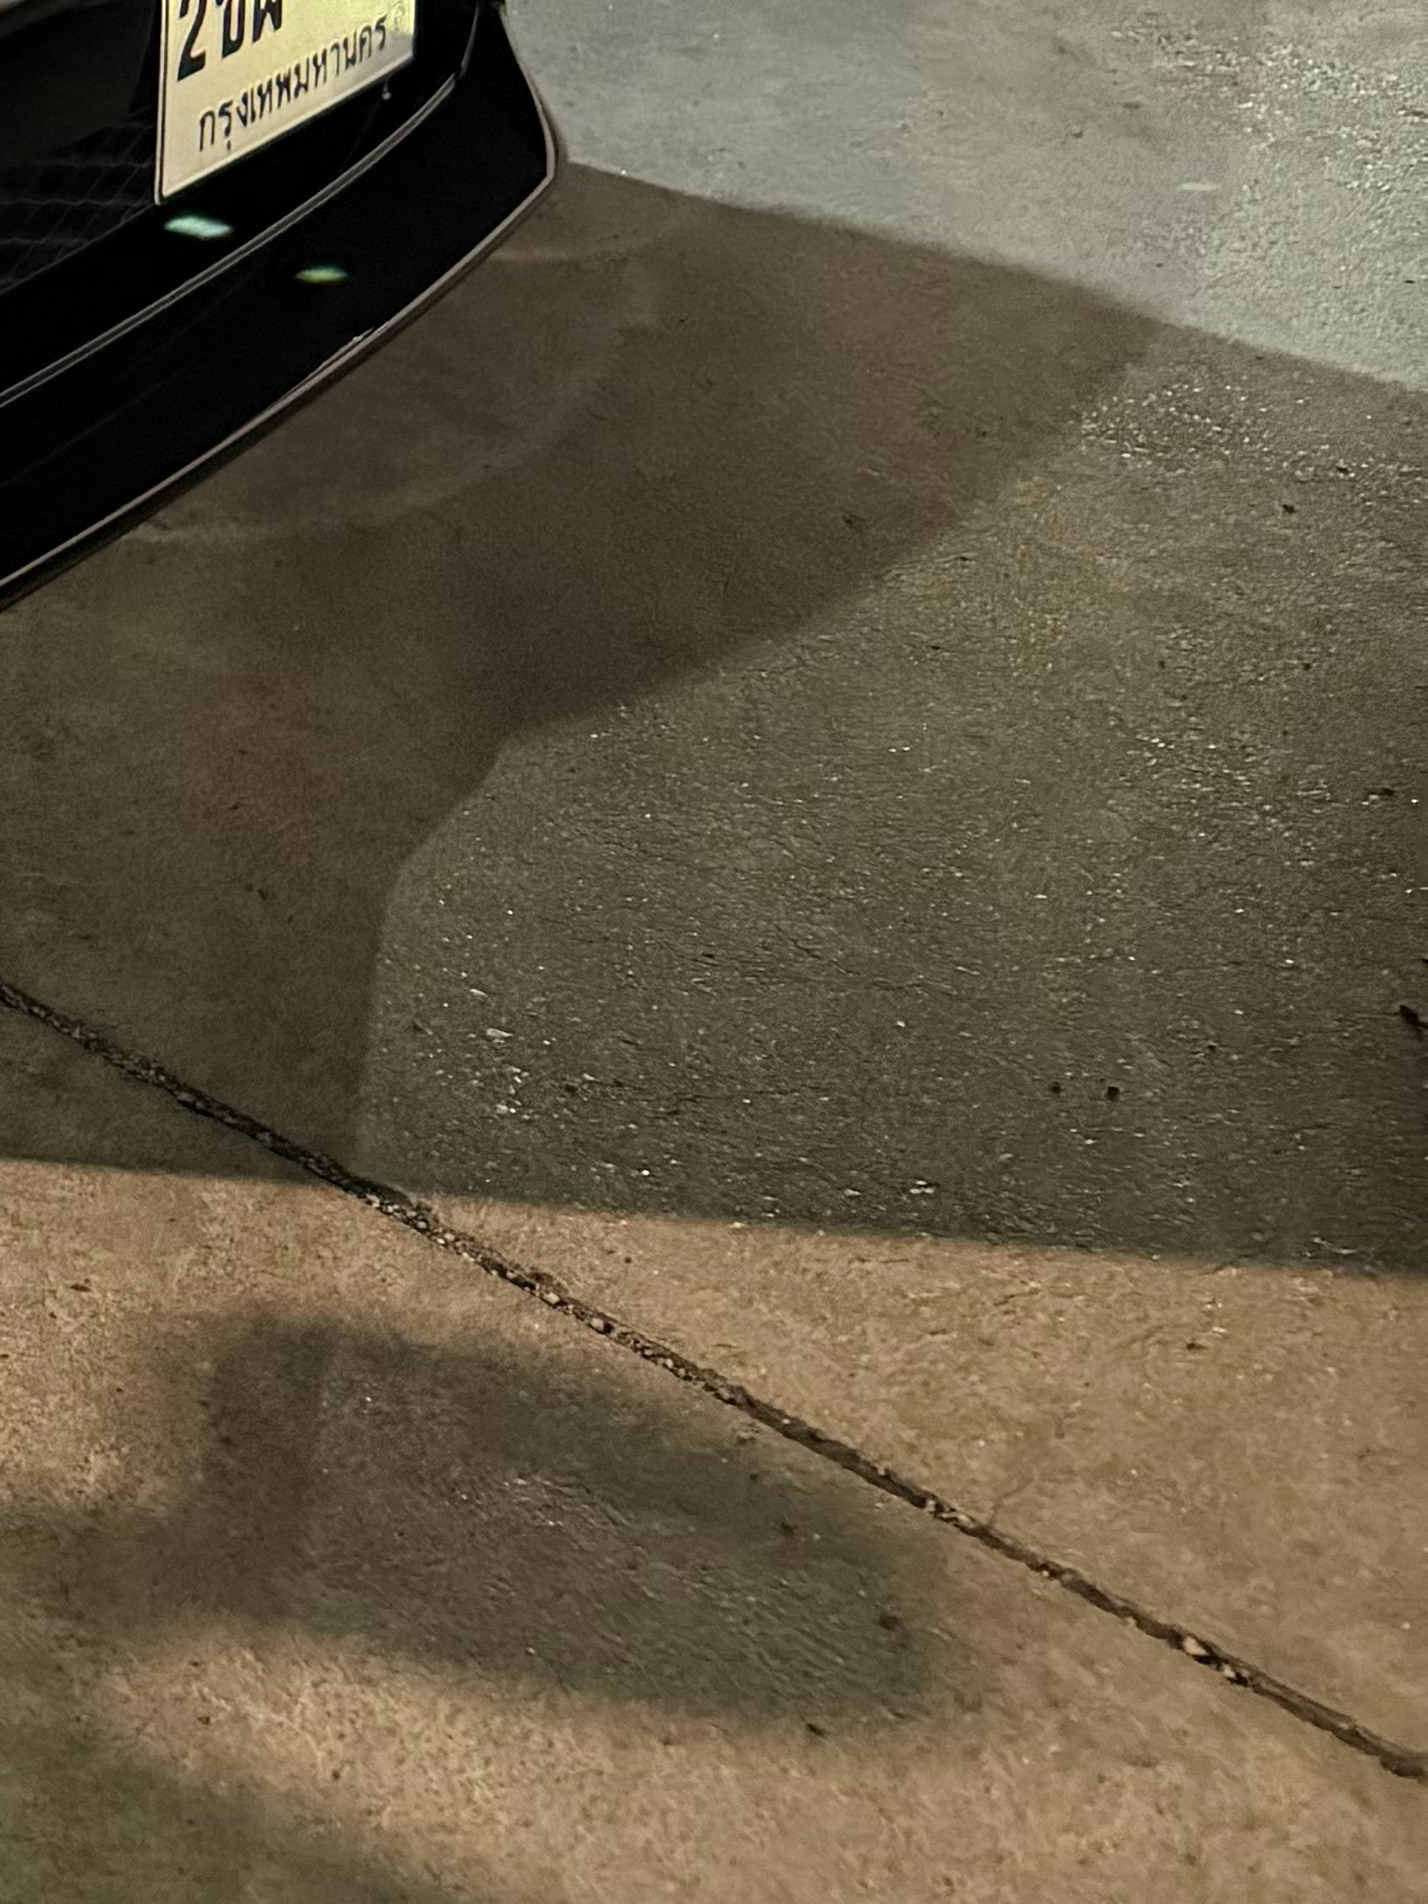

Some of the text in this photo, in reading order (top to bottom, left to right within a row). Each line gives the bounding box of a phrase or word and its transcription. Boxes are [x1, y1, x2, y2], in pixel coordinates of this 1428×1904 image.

[198, 13, 388, 153] กรุงเทพมหานคร
